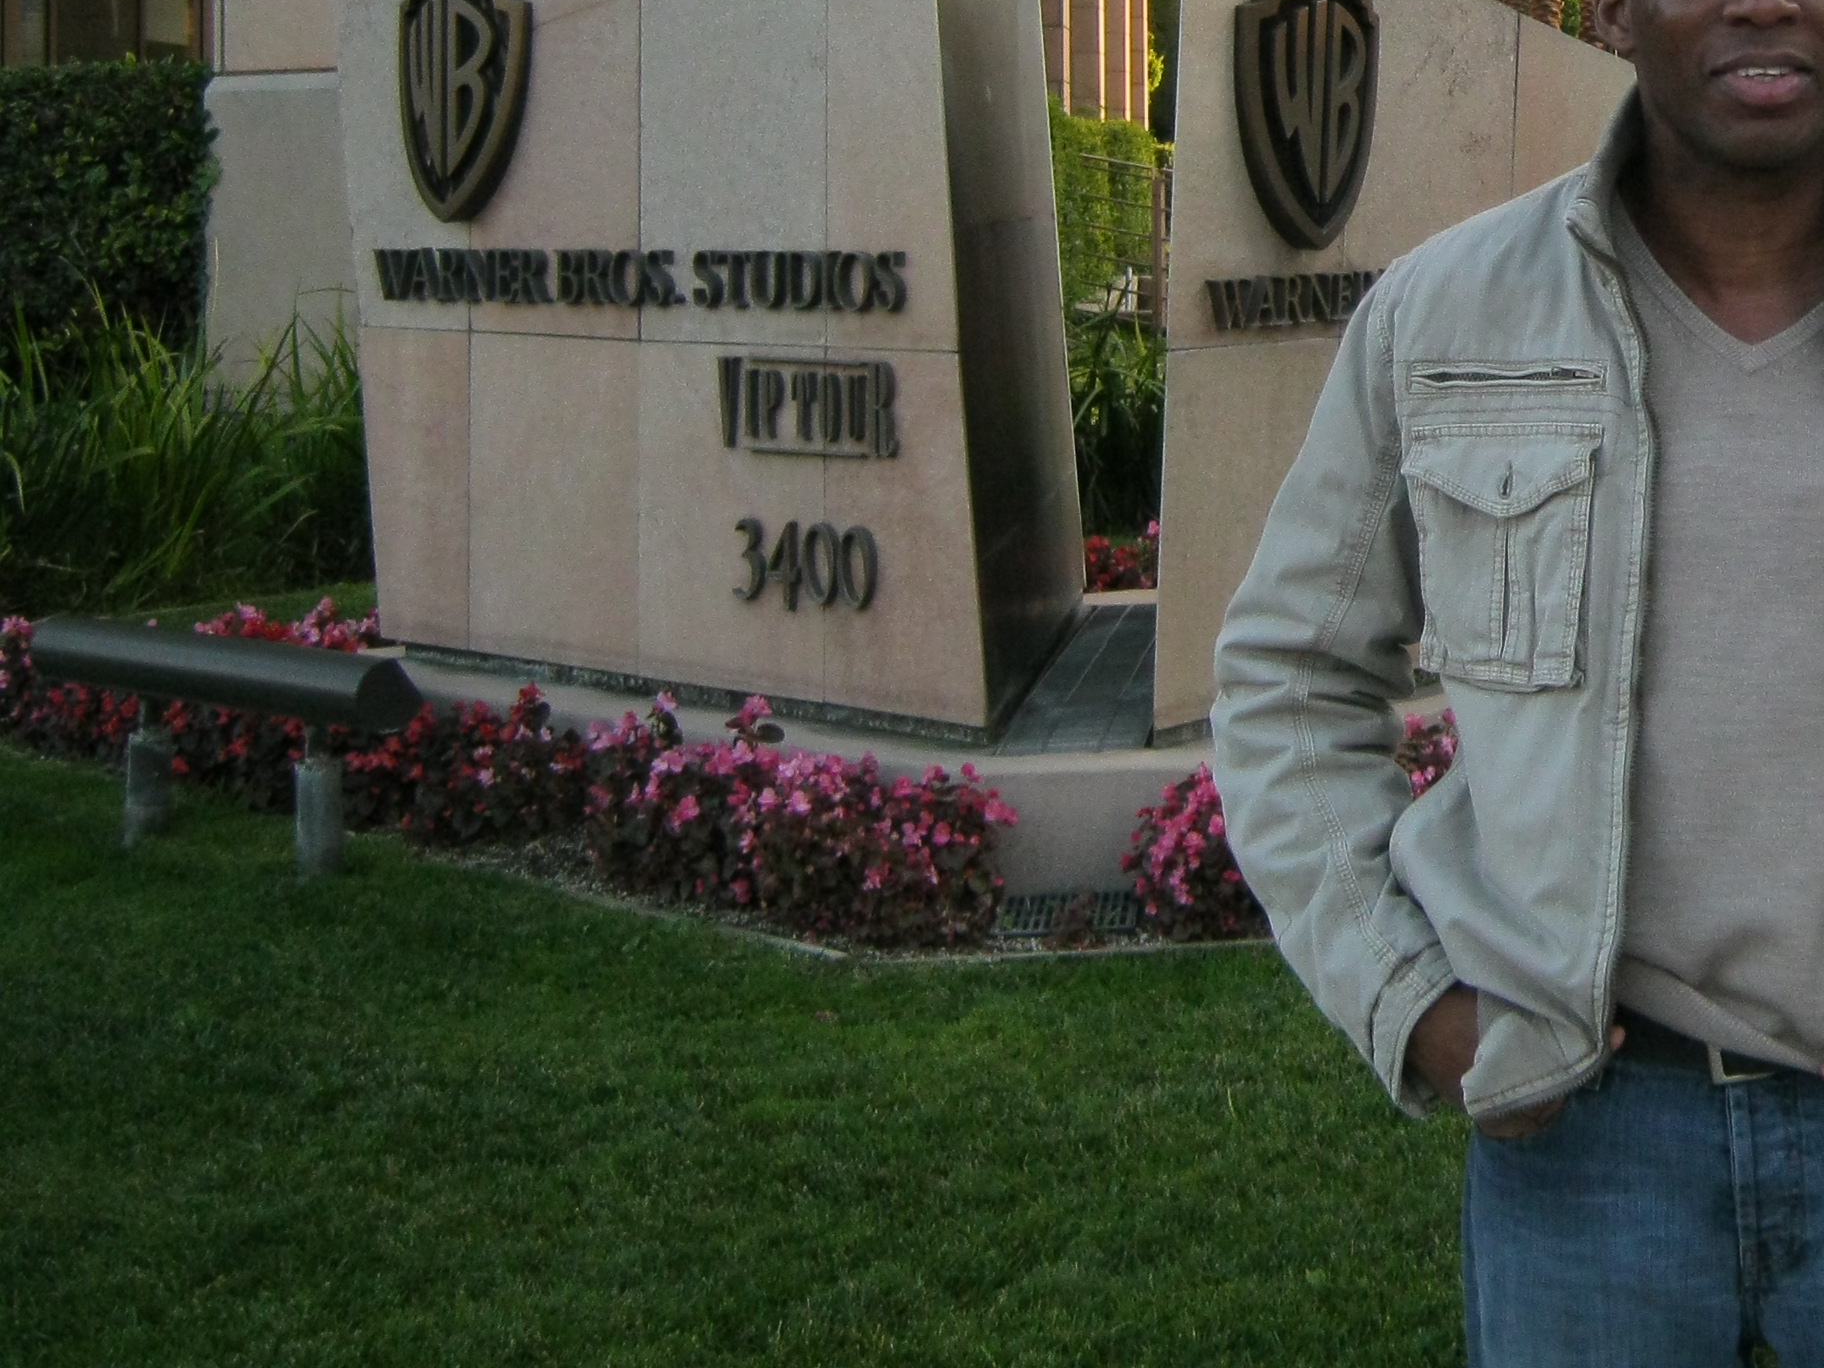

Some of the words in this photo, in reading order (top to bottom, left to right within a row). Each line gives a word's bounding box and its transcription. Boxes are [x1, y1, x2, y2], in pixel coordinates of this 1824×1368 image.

[373, 247, 554, 305] WARNER
[554, 249, 686, 308] BROS.
[692, 250, 908, 312] STUDIOS
[718, 356, 785, 448] VIP
[790, 360, 900, 458] TOUR
[732, 517, 878, 612] 3400
